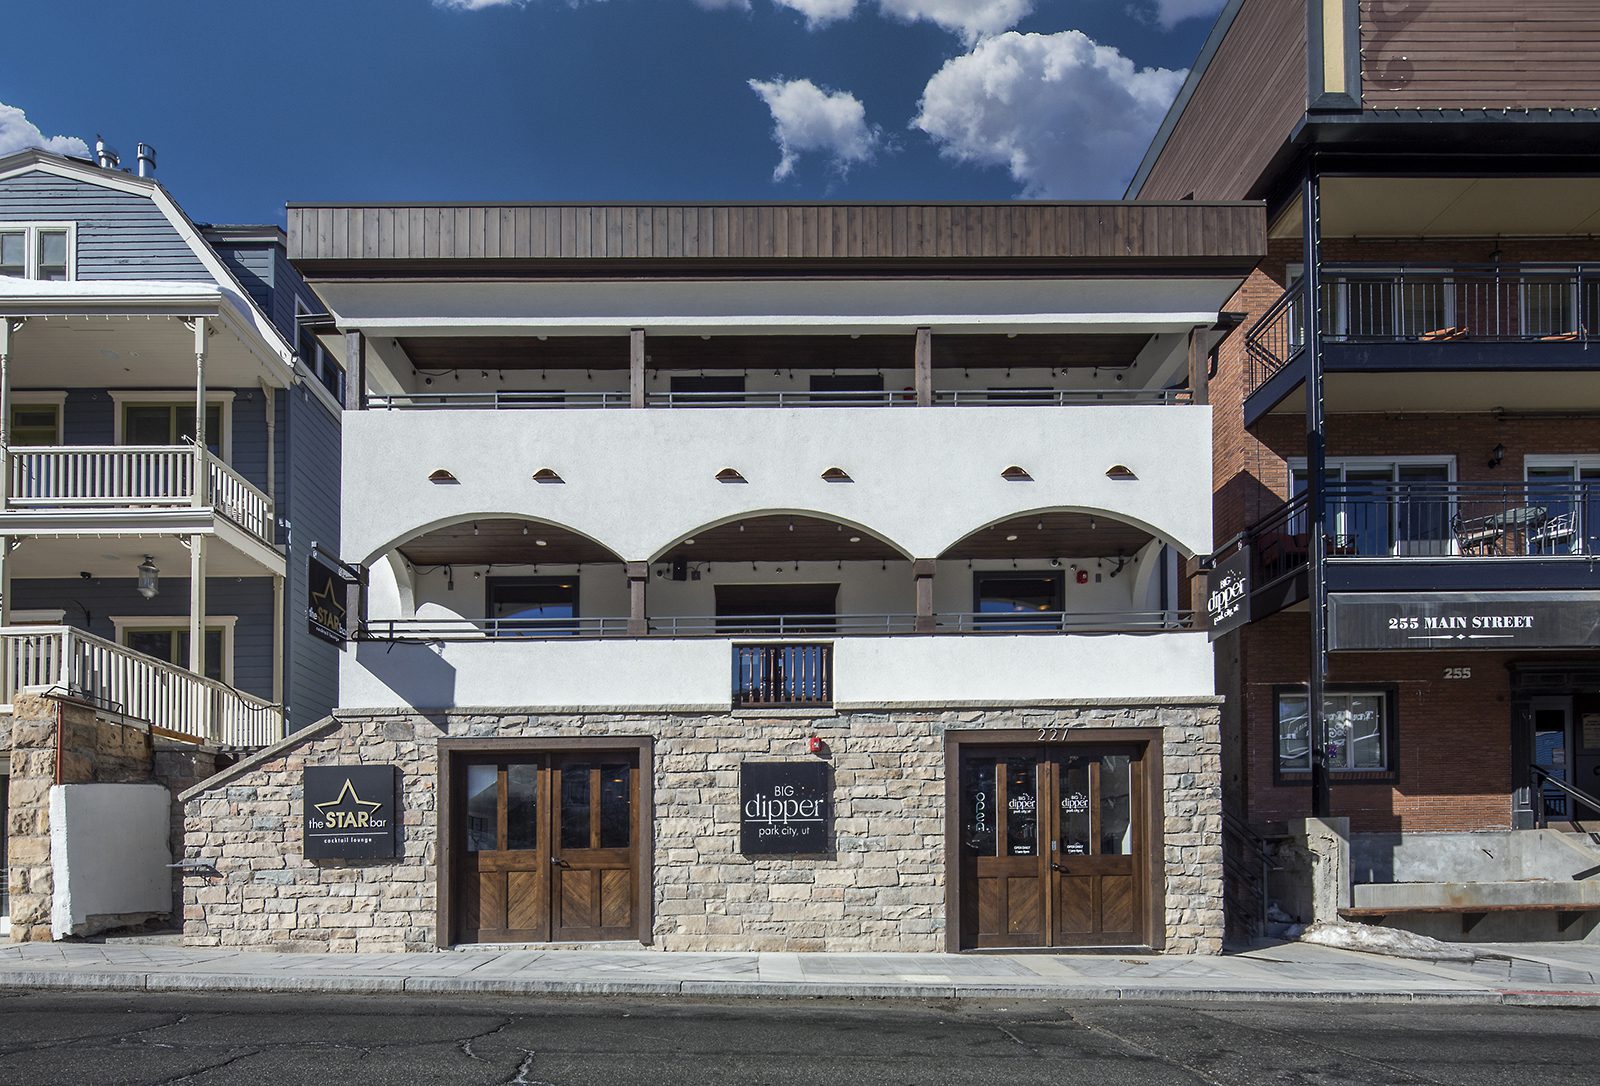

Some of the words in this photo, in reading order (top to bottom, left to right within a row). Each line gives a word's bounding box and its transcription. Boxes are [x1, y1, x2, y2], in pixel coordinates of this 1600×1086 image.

[1208, 578, 1246, 613] dipper
[309, 606, 318, 620] the
[317, 606, 340, 632] STAR
[1388, 617, 1419, 630] 255
[1424, 616, 1467, 629] MAIN
[1472, 615, 1534, 629] STREET
[1443, 667, 1471, 680] 255
[1037, 728, 1069, 741] 227
[774, 785, 794, 797] BIG
[745, 793, 824, 825] dipper
[1008, 798, 1036, 810] dipper
[1061, 797, 1088, 809] dipper
[309, 818, 324, 829] the
[325, 811, 369, 828] STAR
[369, 816, 387, 828] bar
[758, 824, 780, 838] park
[781, 826, 799, 837] city,
[801, 827, 810, 835] ut
